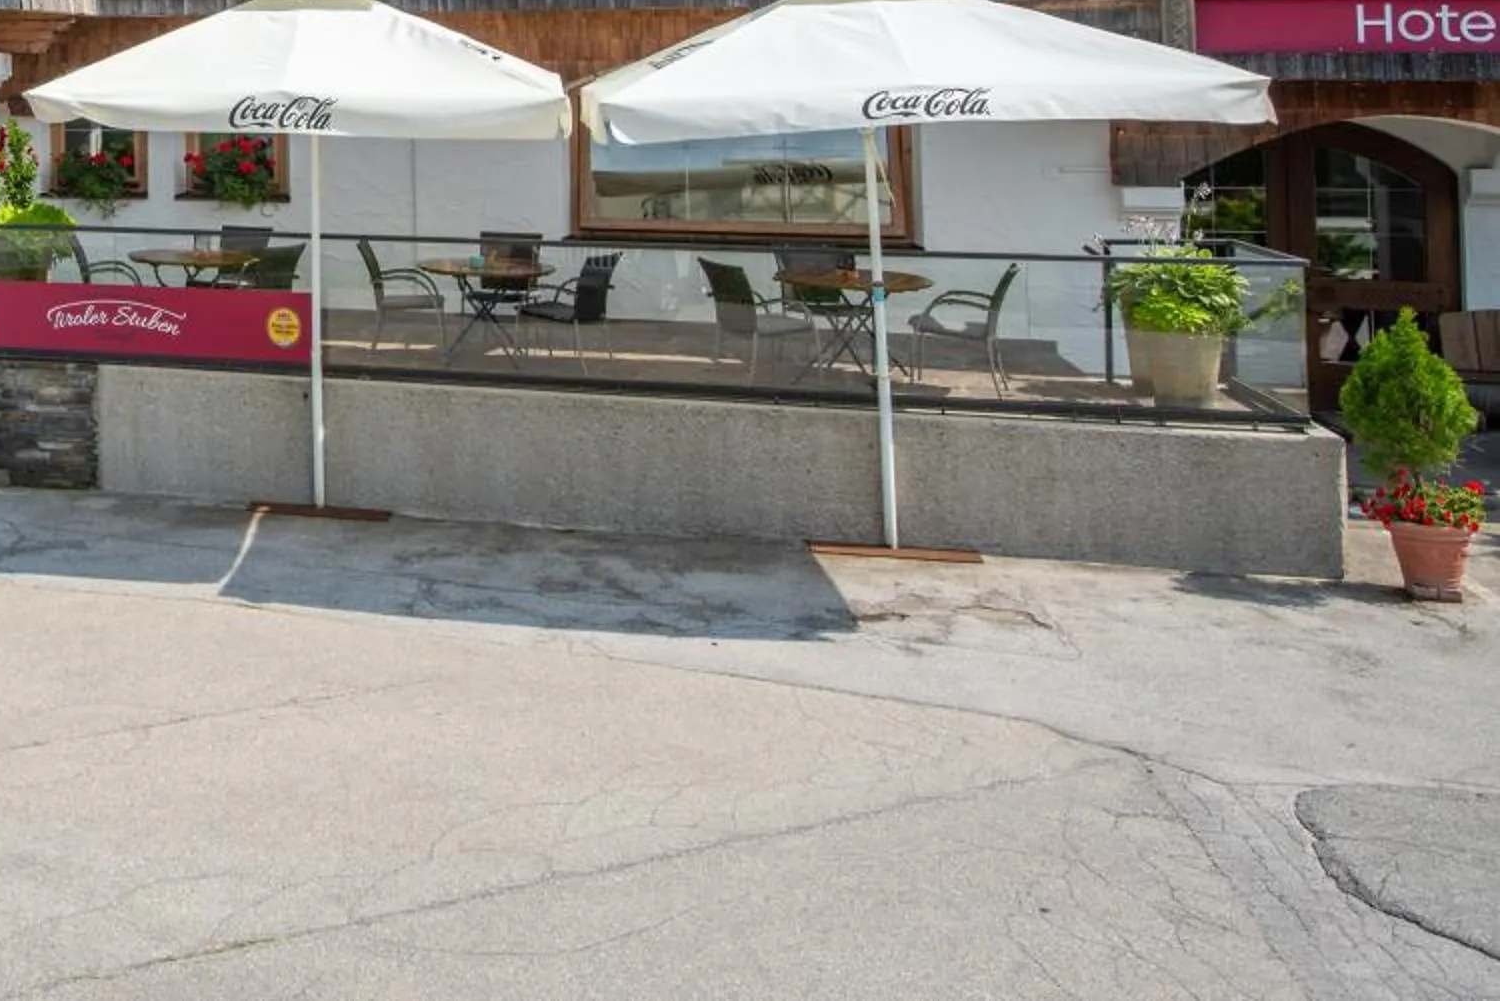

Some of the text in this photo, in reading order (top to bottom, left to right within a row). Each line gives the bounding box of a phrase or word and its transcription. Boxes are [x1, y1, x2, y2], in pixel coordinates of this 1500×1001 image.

[228, 95, 338, 130] Coca-Cola
[862, 87, 993, 120] Coca-Cola
[111, 305, 181, 336] Stuben
